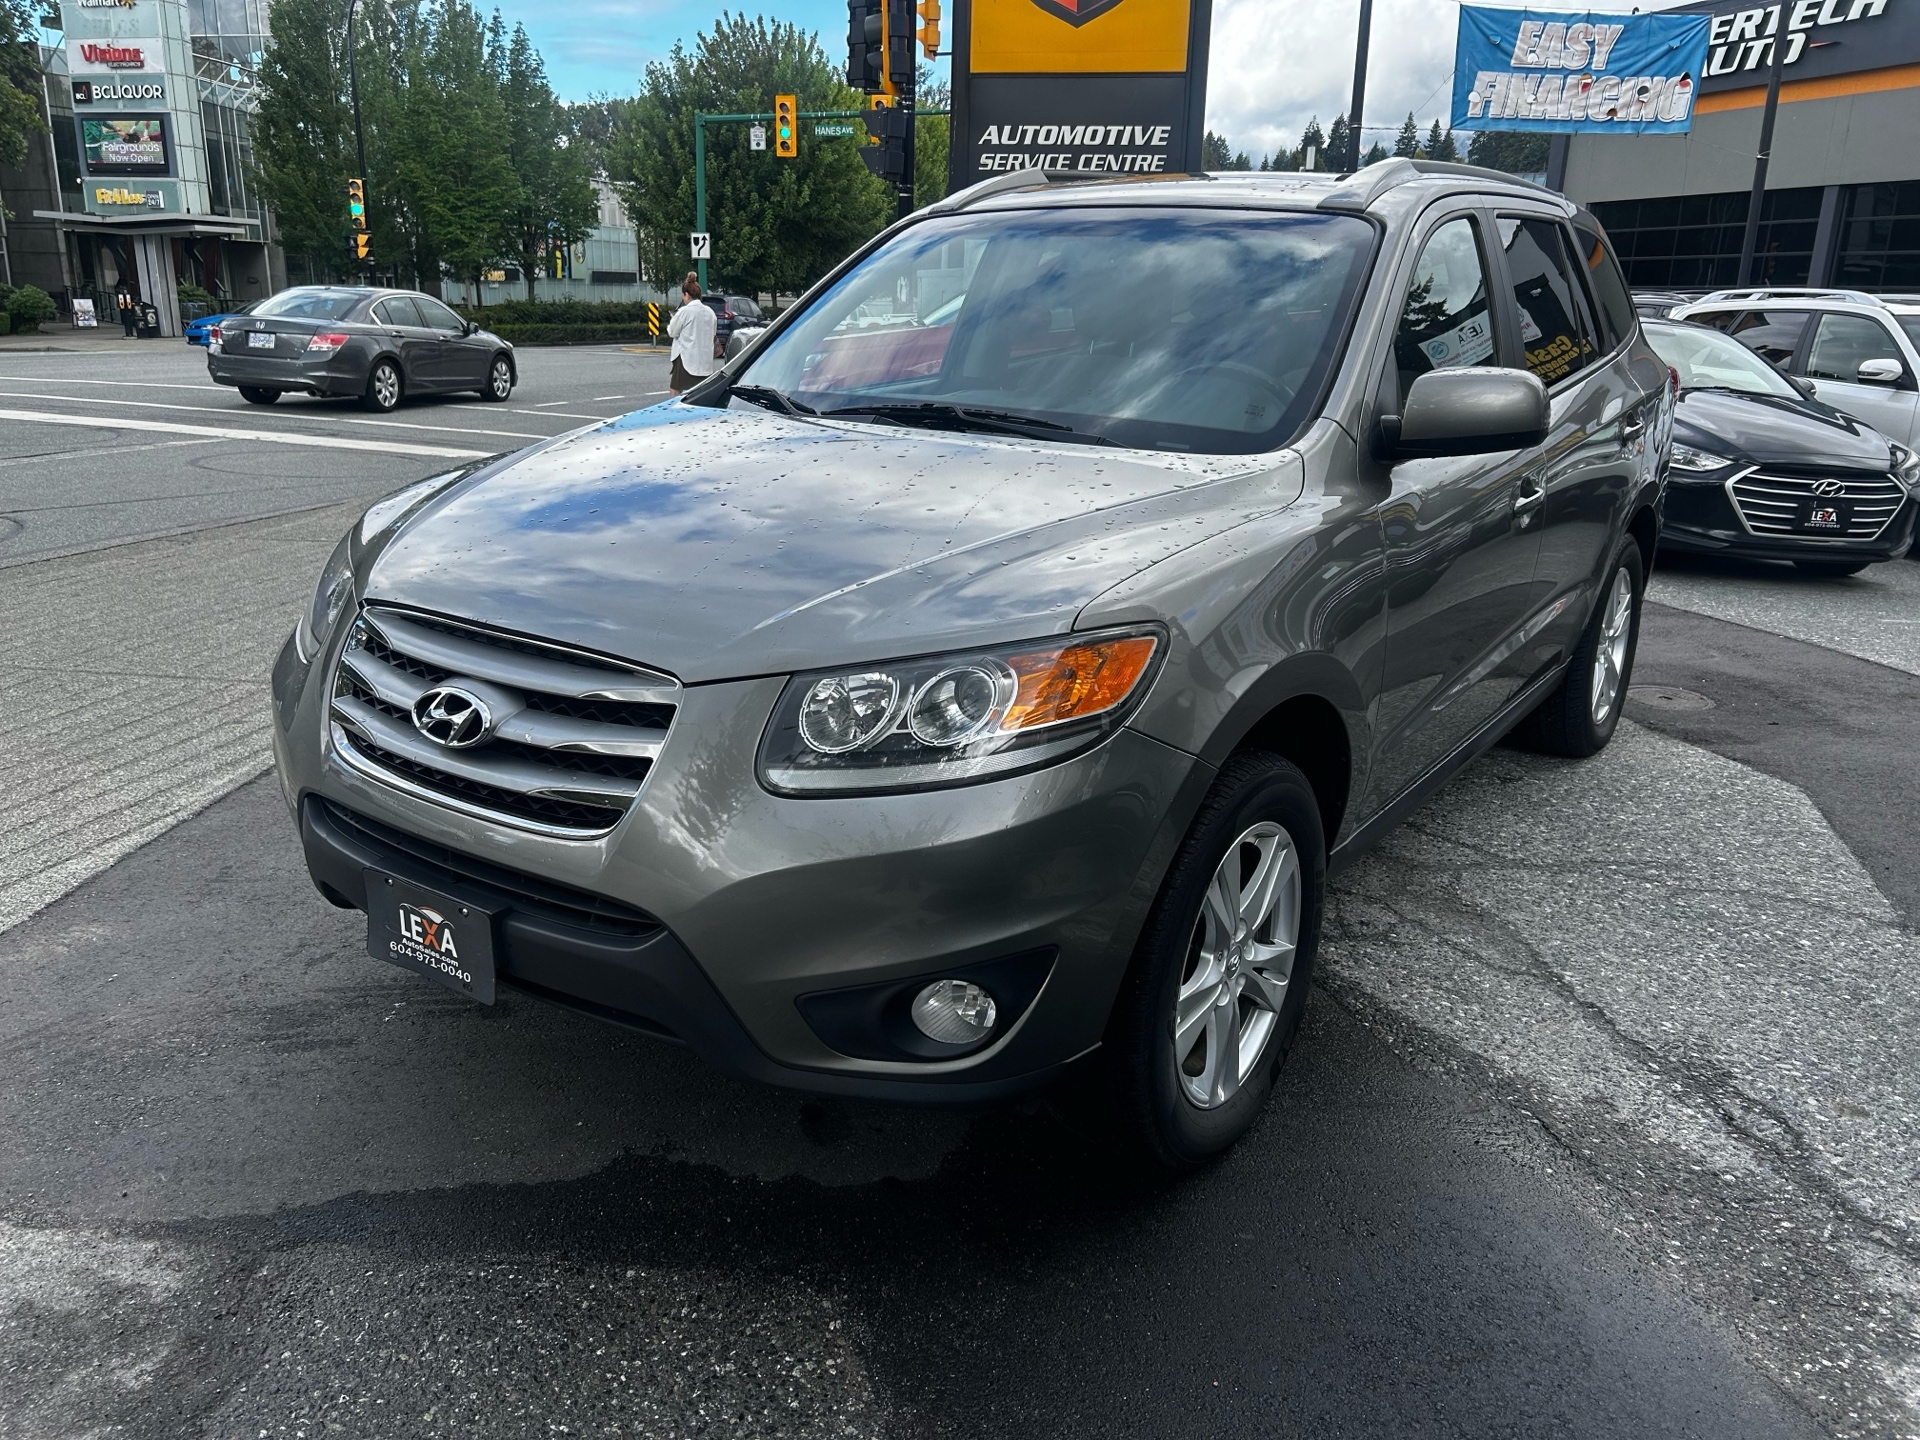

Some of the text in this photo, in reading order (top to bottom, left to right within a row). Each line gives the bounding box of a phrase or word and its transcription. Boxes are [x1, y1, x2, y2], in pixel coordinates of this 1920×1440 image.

[1511, 20, 1624, 70] EASY
[1467, 70, 1693, 122] FINANCING
[815, 126, 841, 135] HANES
[978, 125, 1171, 146] AUTOMOTIVE
[102, 143, 160, 153] Fairgrounds
[109, 153, 154, 164] Now Open
[978, 153, 1167, 172] SERVICE CENTRE
[1811, 511, 1837, 521] LEXA
[399, 909, 458, 958] LEXA
[389, 941, 471, 983] 604-971-0040
[401, 938, 459, 967] AutoSales.com
